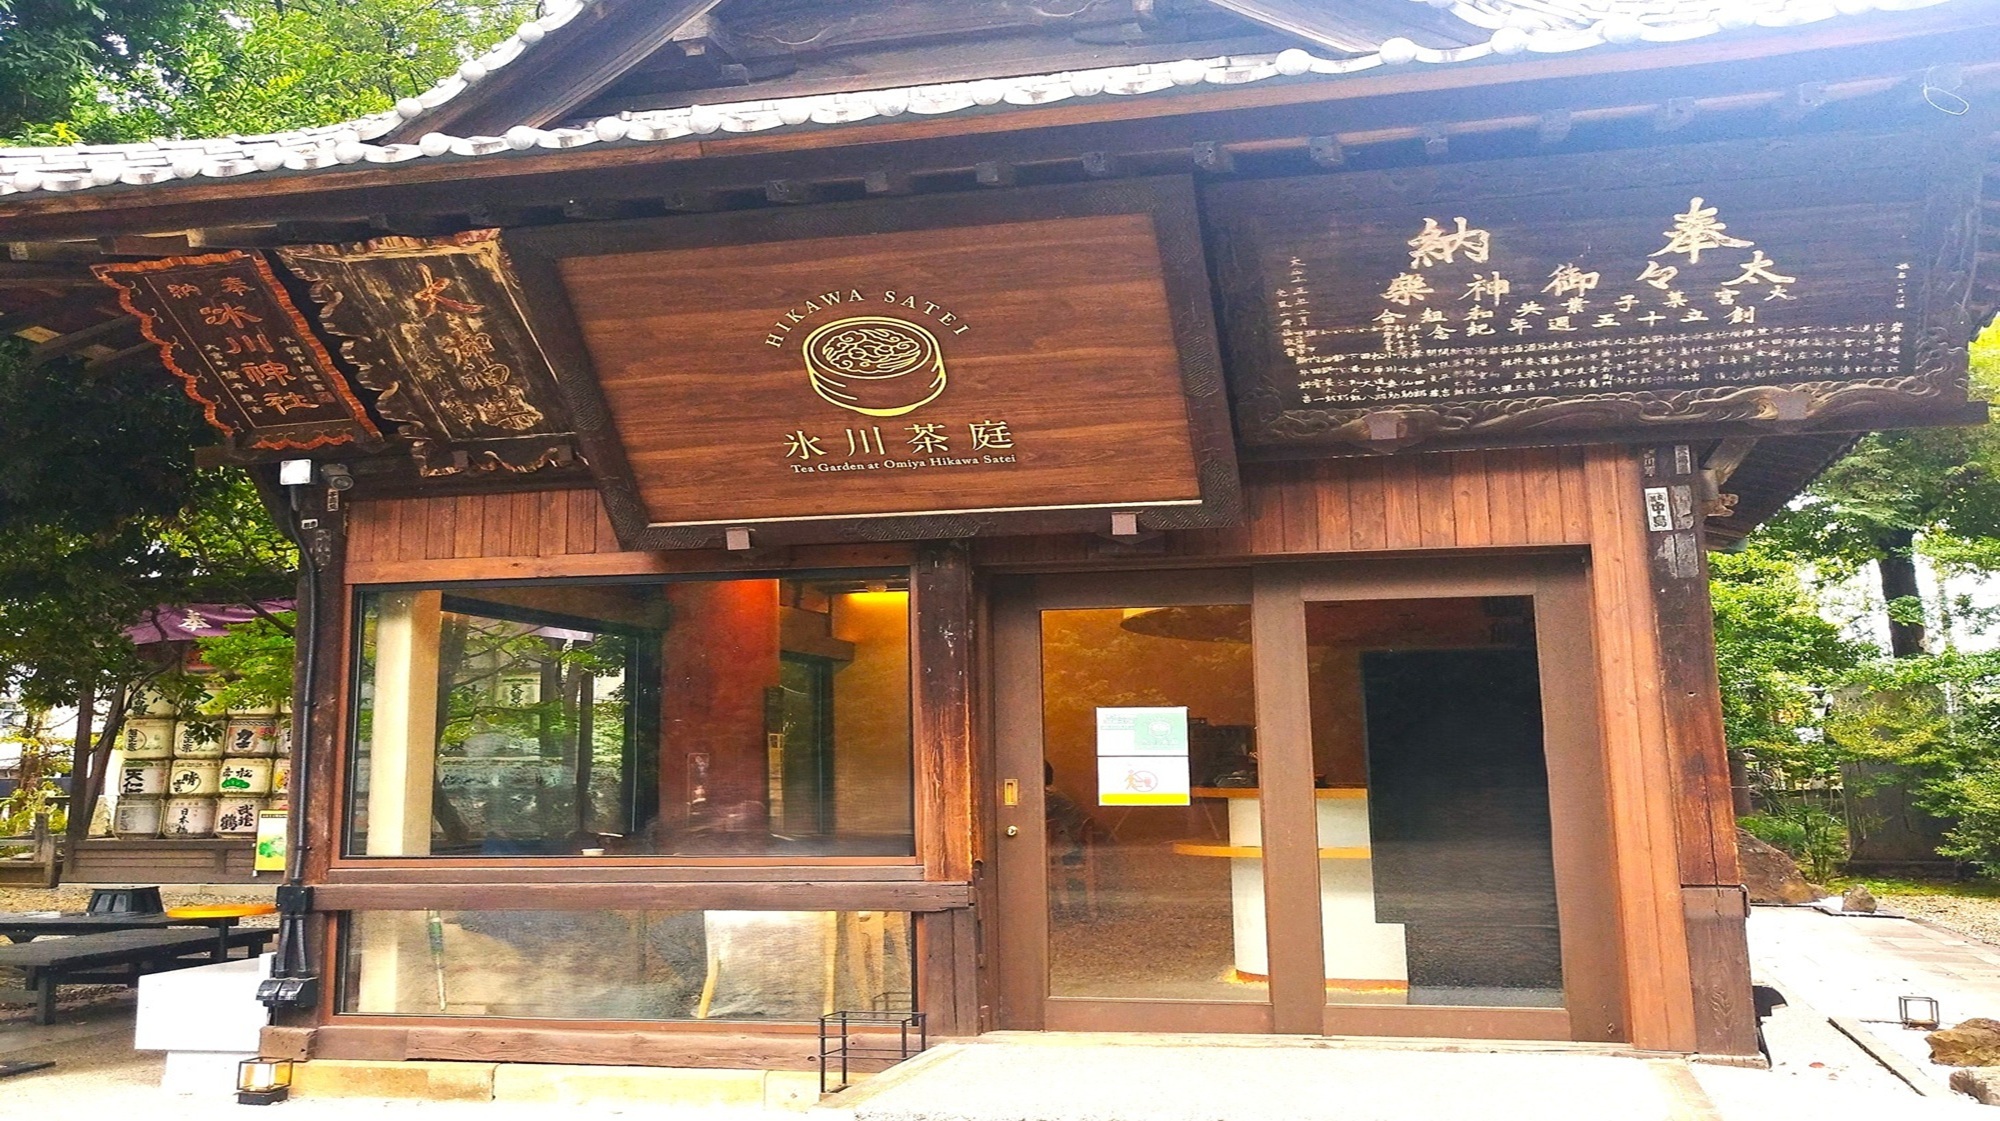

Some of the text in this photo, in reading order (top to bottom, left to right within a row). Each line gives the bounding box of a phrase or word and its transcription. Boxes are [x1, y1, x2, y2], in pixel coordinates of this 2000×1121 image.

[765, 289, 971, 348] HIKAWA SATEI
[783, 420, 1015, 459] 氷川茶庭
[791, 464, 815, 473] Tea
[818, 462, 865, 473] Garden
[883, 459, 926, 470] Omiya
[930, 457, 979, 467] Hikawa
[983, 454, 1017, 464] Satei
[178, 609, 212, 632] 奉
